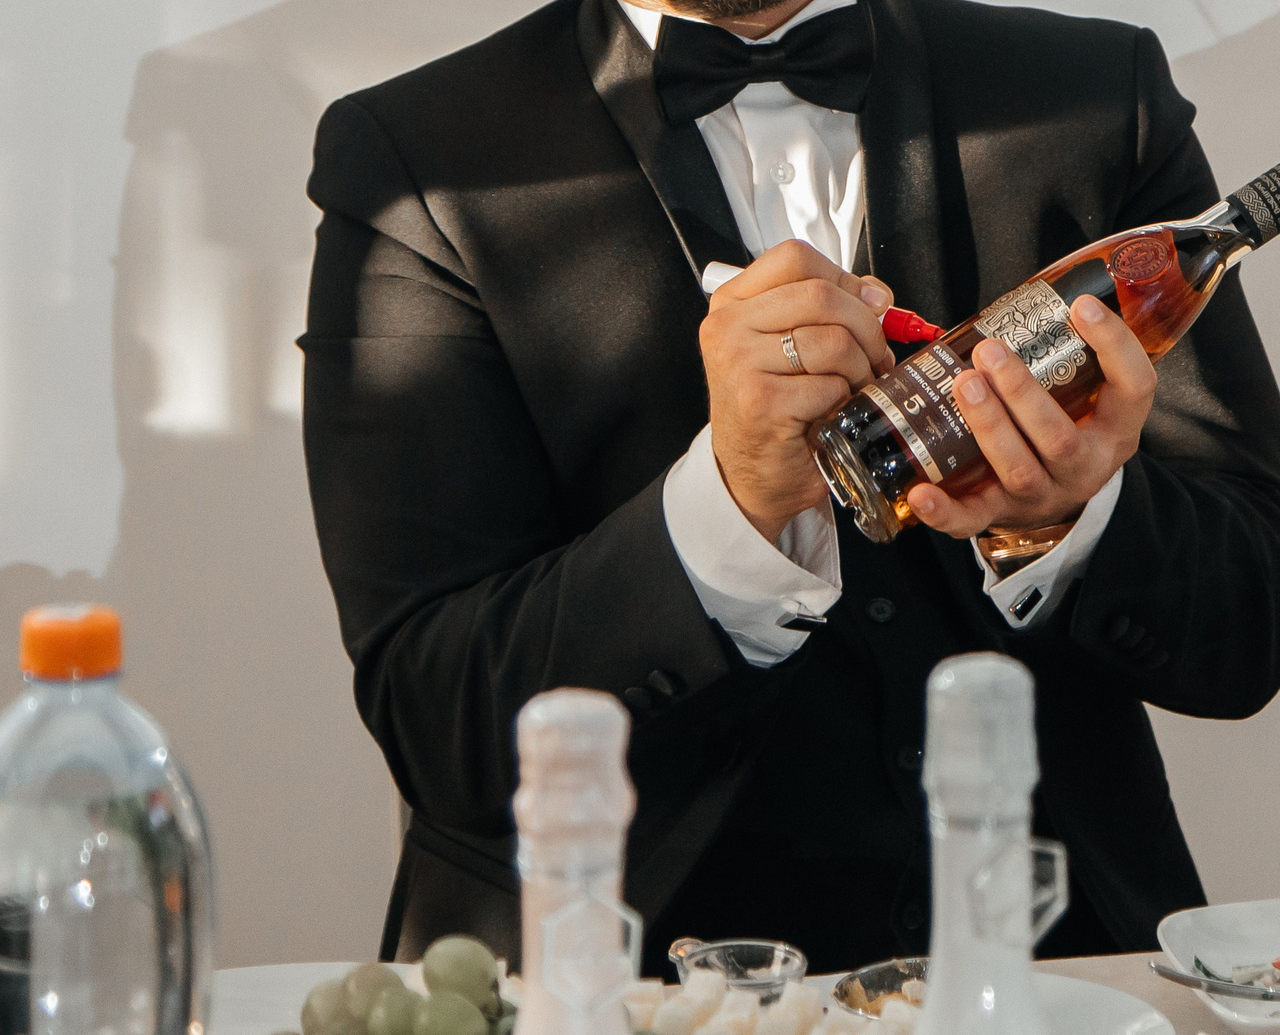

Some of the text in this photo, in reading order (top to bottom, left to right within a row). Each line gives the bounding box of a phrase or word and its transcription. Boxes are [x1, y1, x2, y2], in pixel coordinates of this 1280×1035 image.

[912, 351, 947, 380] DAVID
[903, 364, 941, 403] ГРУЗИНСКИЙ
[937, 403, 965, 440] КОНЬЯК
[903, 393, 927, 415] 5
[891, 411, 904, 423] OF
[903, 426, 933, 467] GEORGIA
